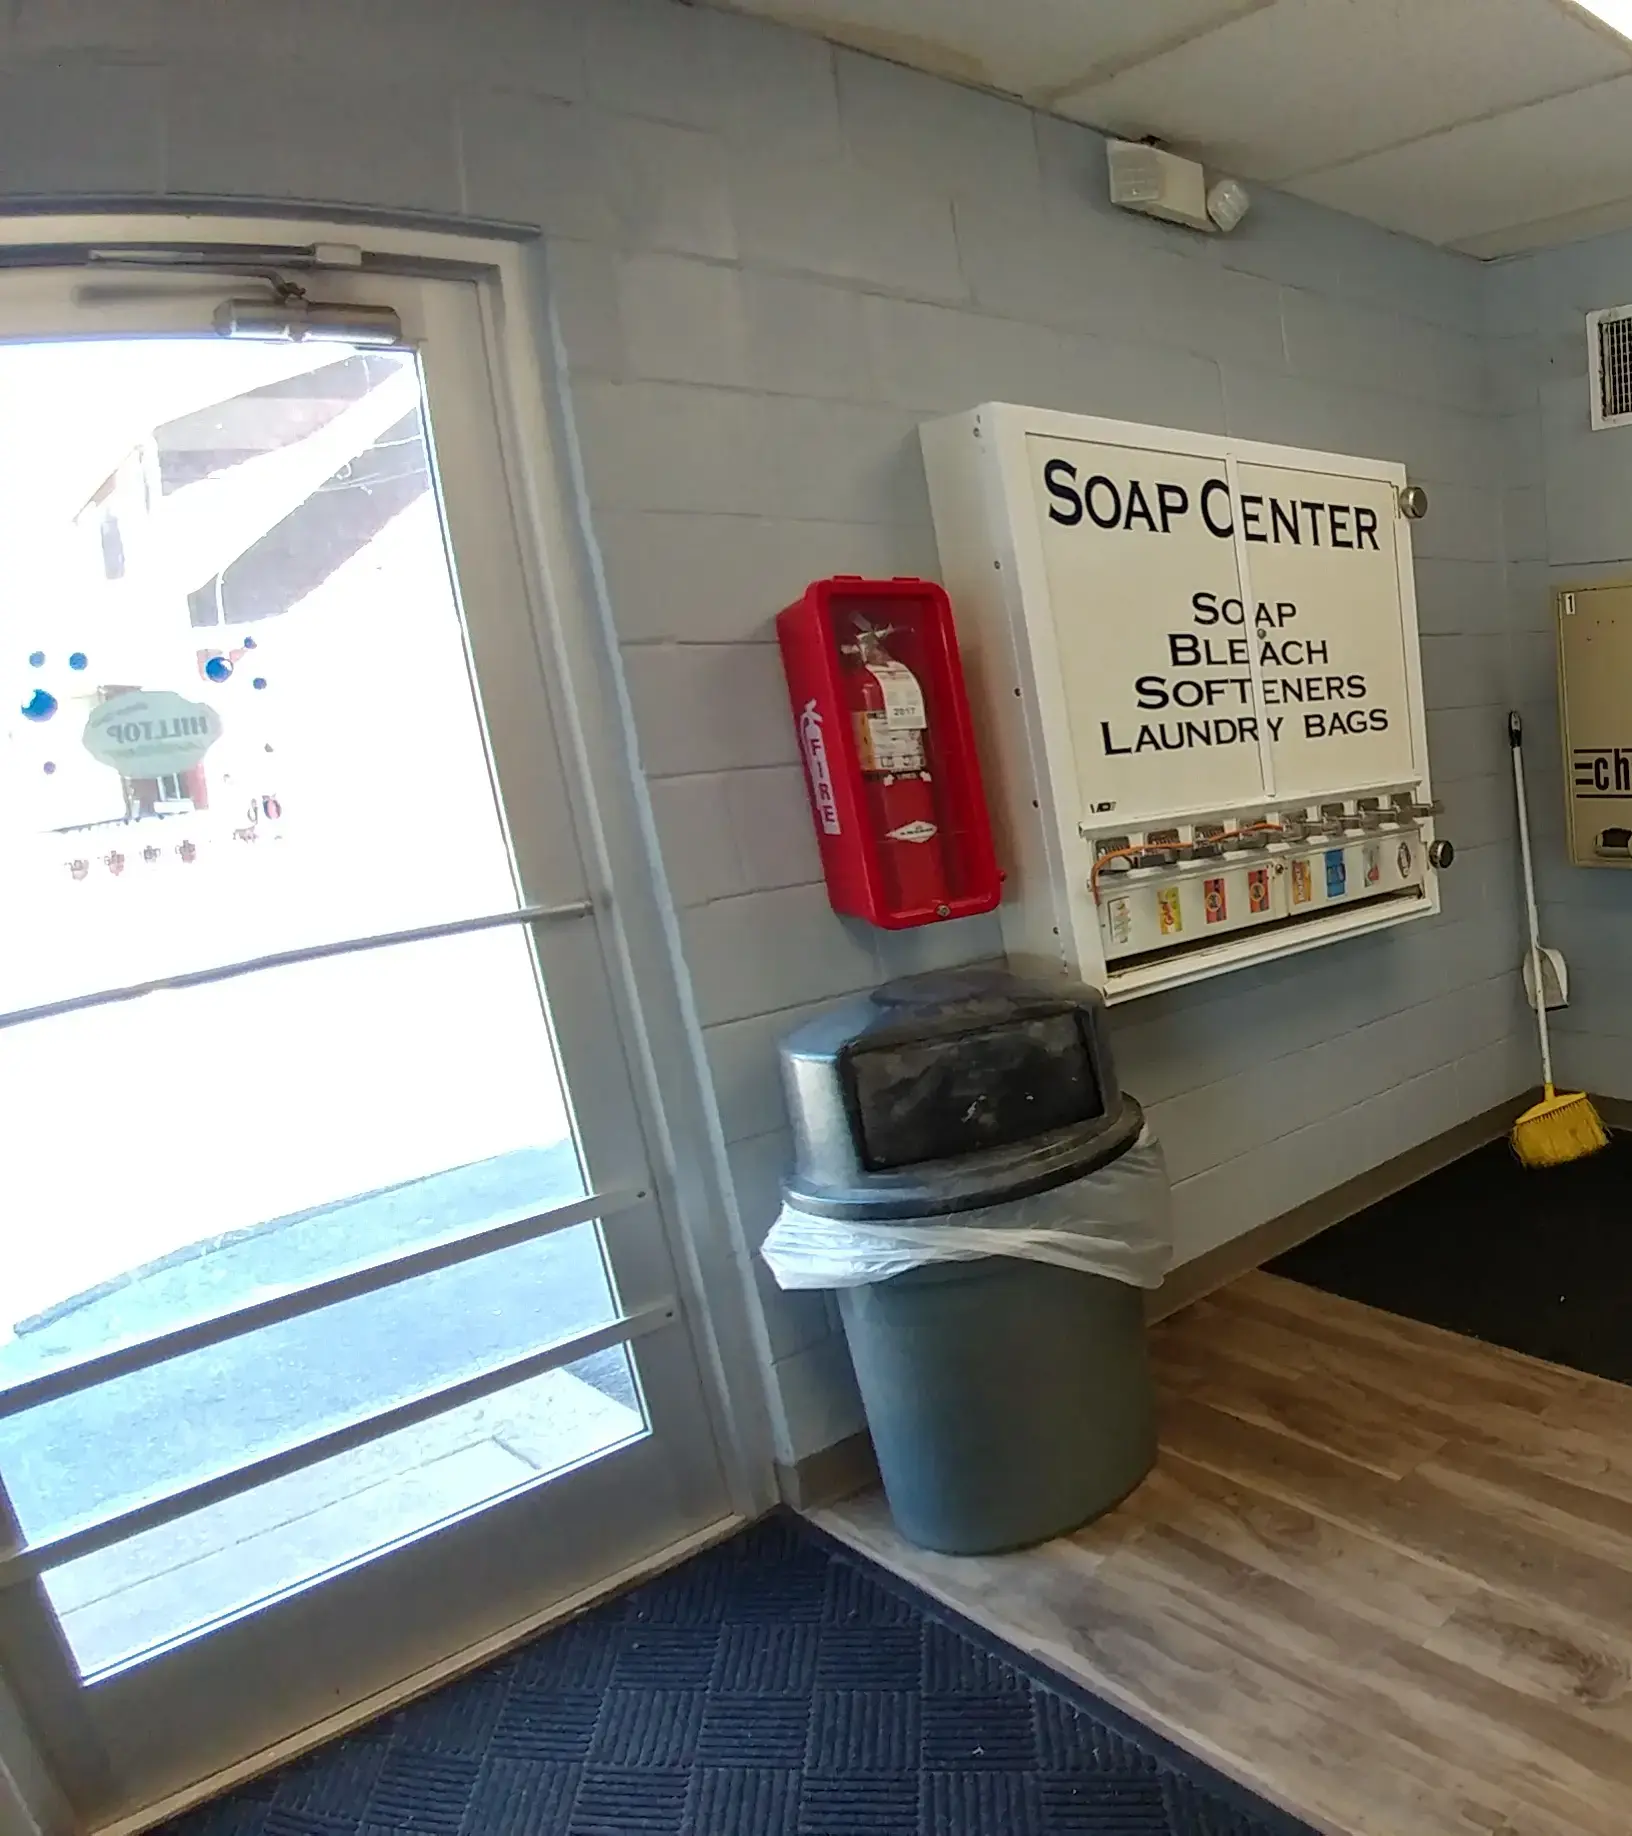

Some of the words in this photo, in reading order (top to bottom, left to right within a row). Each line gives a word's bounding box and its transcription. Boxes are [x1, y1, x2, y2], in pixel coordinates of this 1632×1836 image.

[1043, 458, 1189, 534] SOAP
[1200, 478, 1381, 551] CENTER
[1191, 592, 1297, 628] SOAP
[1566, 595, 1574, 613] 1
[1167, 632, 1329, 667] BLEACH
[1134, 674, 1367, 709] SOFTENERS
[1100, 716, 1284, 756] LAUNDRY
[1303, 708, 1389, 739] BAGS
[811, 738, 836, 823] FIRE
